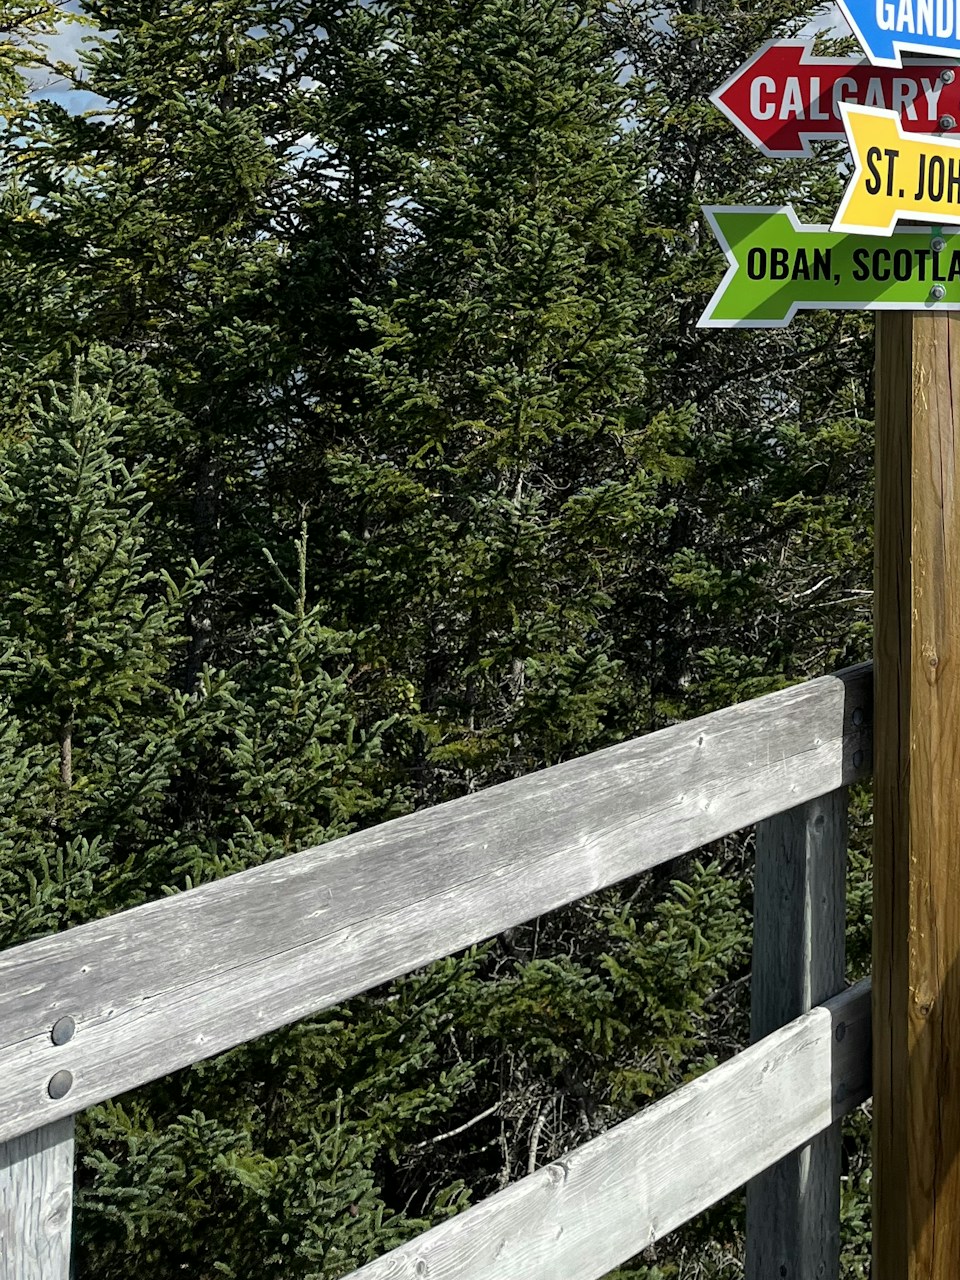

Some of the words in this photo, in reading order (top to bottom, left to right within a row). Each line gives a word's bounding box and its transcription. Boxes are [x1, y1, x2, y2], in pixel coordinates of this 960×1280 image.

[750, 75, 945, 121] CALGARY
[865, 146, 904, 199] ST.
[747, 246, 840, 286] OBAN,
